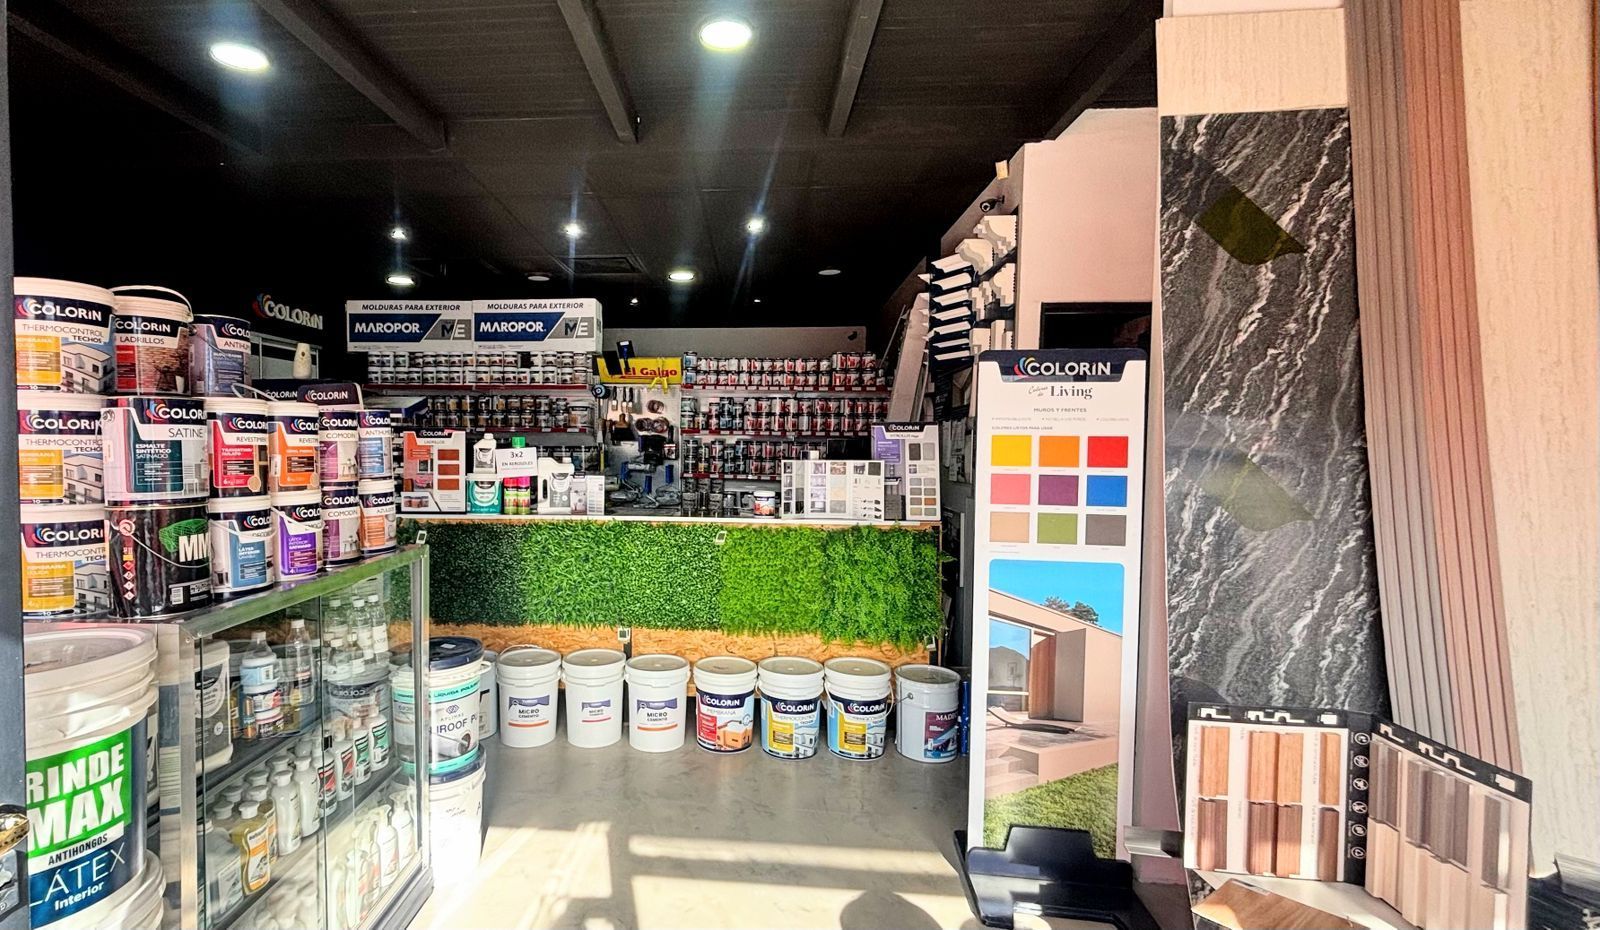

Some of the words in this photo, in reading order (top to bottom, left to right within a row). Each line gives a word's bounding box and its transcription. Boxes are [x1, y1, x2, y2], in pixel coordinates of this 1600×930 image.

[29, 303, 102, 322] COLORIN
[361, 303, 403, 311] MOLDURAS
[404, 303, 424, 311] PARA
[425, 303, 461, 311] EXTERIOR
[528, 302, 548, 310] PARA
[549, 301, 584, 309] EXTERIOR
[263, 300, 323, 330] COLORIN
[22, 323, 104, 338] THERMOCONTROL
[114, 318, 171, 333] COLORIN
[72, 335, 102, 343] TECHOS
[119, 336, 165, 345] LADRILLOS
[1026, 361, 1111, 376] COLORIN
[311, 390, 349, 400] COLORIN
[1050, 385, 1094, 400] Living
[510, 451, 524, 459] 3x2
[707, 697, 740, 707] COLORIN
[780, 703, 815, 712] COLORIN
[26, 743, 125, 804] RINDE
[26, 777, 124, 852] MAX
[48, 833, 108, 866] ANTIHONGOS
[29, 842, 126, 907] ÁTEX
[54, 881, 105, 912] Interior
